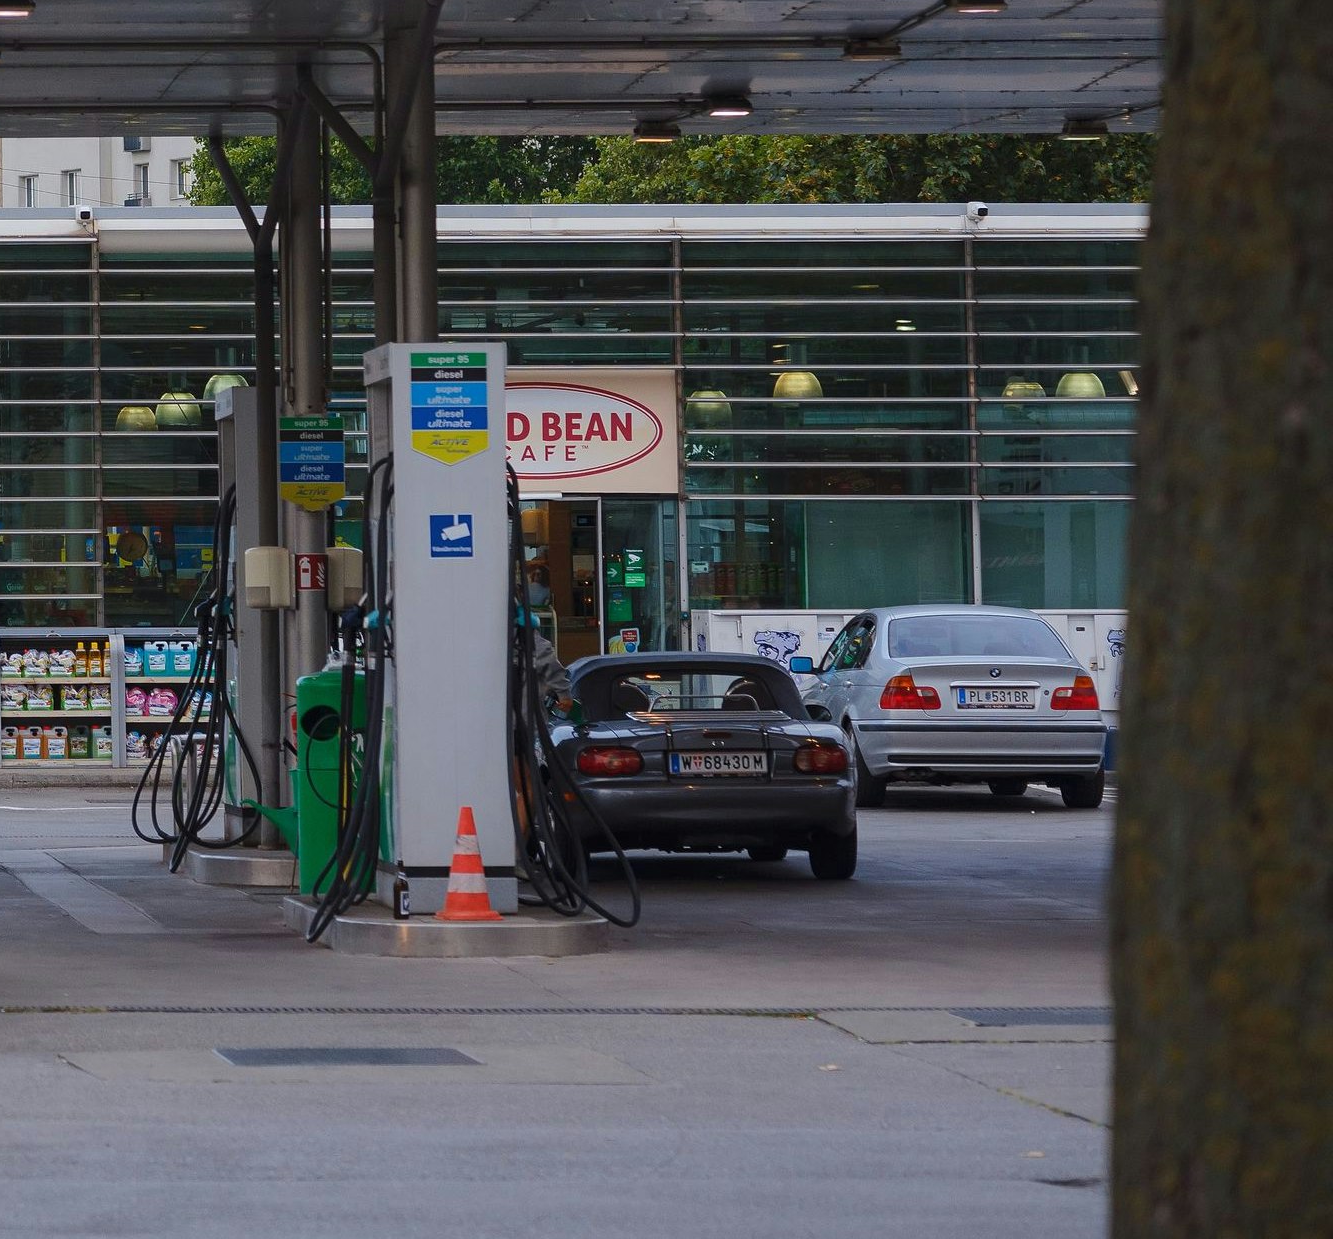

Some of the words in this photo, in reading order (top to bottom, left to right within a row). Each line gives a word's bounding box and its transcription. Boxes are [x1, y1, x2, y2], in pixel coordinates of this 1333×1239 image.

[428, 356, 455, 366] super
[457, 355, 470, 364] 95
[434, 369, 464, 379] diesel
[435, 409, 464, 418] diesel
[294, 420, 318, 428] super
[542, 412, 633, 442] BEAN
[299, 431, 324, 440] diesel
[300, 464, 324, 472] diesel
[969, 691, 983, 702] PL
[681, 755, 692, 770] W
[704, 755, 750, 770] 68430
